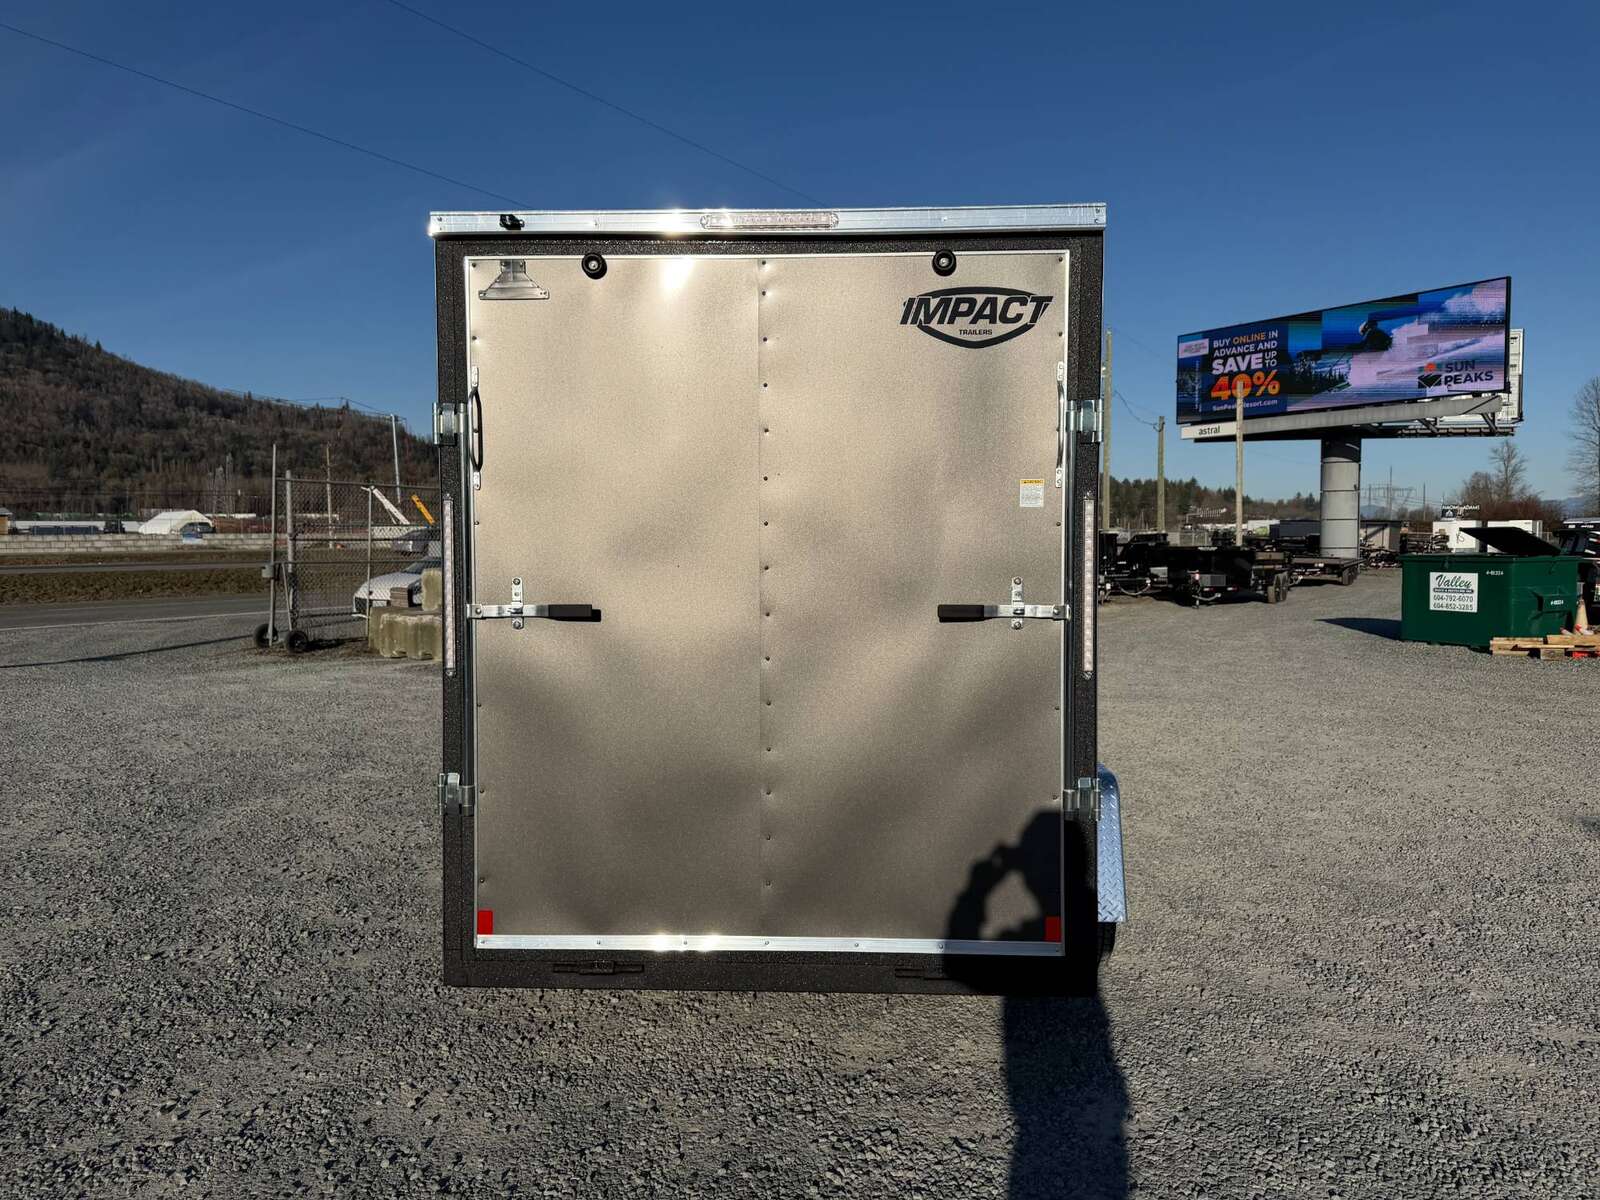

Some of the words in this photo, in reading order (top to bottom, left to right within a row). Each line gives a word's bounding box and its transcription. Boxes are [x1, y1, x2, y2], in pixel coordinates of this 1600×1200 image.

[900, 295, 1053, 325] IMPACT
[1213, 338, 1230, 348] BUY
[1232, 333, 1266, 345] ONLINE
[1268, 330, 1279, 339] IN
[1213, 344, 1255, 357] ADVANCE
[1257, 341, 1277, 351] AND
[1265, 351, 1277, 359] UP
[1212, 353, 1263, 375] SAVE
[1445, 360, 1475, 373] SUN
[1210, 369, 1280, 400] 40%
[1444, 371, 1494, 386] PEAKS
[1198, 425, 1220, 435] astral
[1435, 574, 1472, 588] Valley
